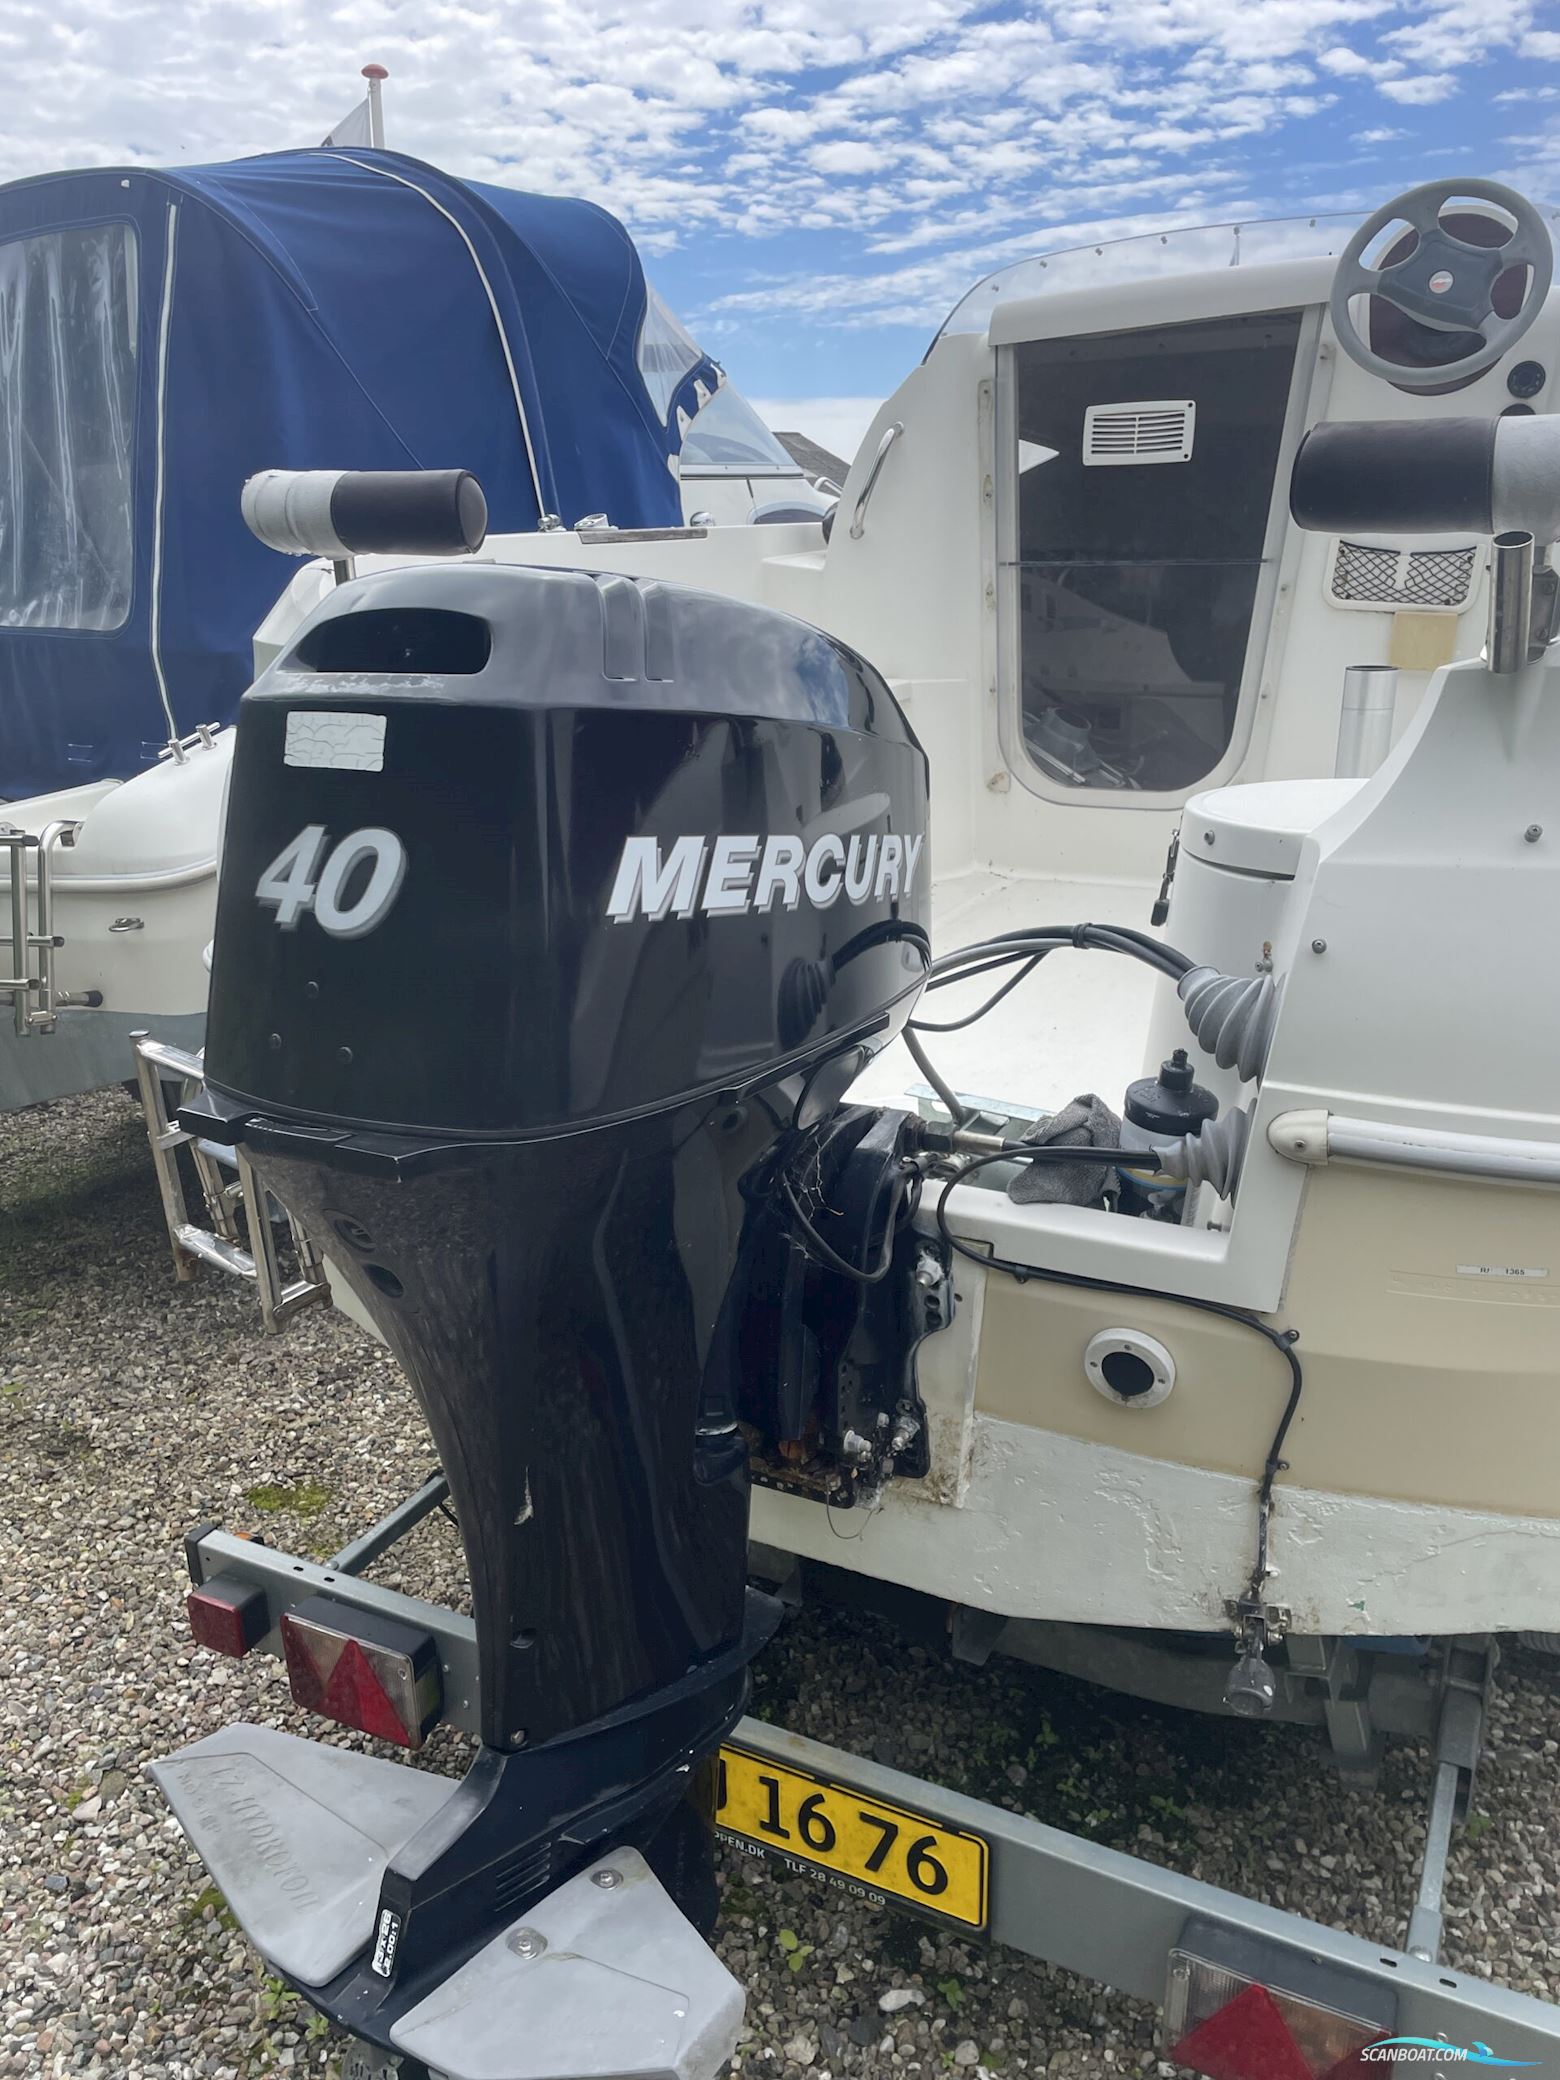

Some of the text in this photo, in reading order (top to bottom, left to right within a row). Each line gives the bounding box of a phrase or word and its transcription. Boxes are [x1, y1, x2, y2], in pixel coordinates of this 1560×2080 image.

[255, 823, 409, 940] 40
[604, 832, 924, 925] MERCURY
[758, 1775, 836, 1852] 16
[859, 1810, 948, 1896] 76
[783, 1858, 807, 1875] TLF
[809, 1868, 827, 1883] 28
[829, 1878, 846, 1890] 49
[848, 1885, 866, 1898] 09
[868, 1892, 887, 1906] 09
